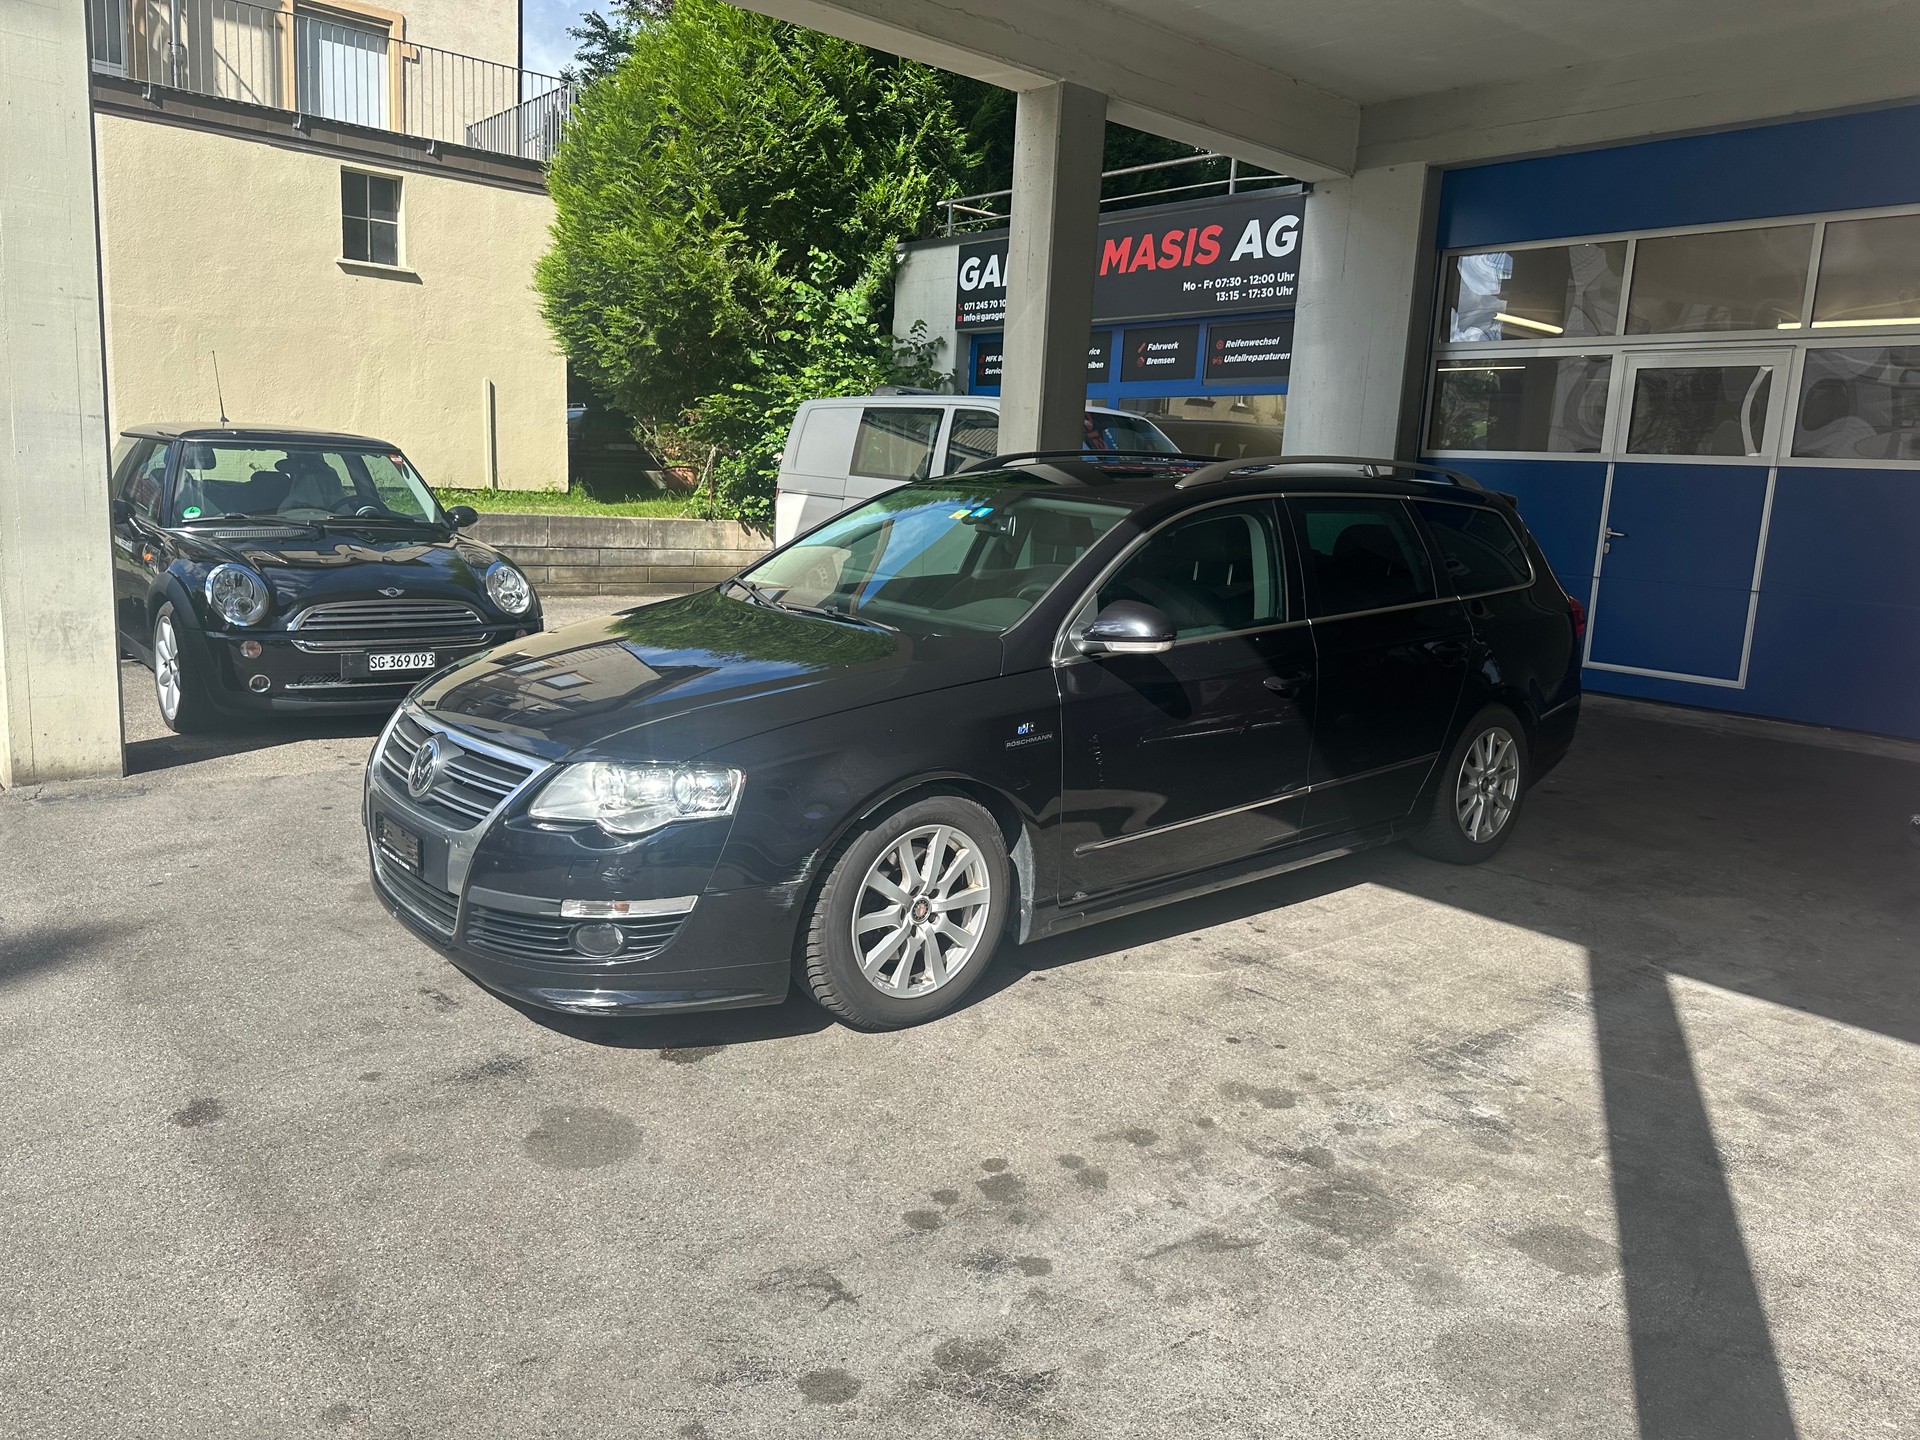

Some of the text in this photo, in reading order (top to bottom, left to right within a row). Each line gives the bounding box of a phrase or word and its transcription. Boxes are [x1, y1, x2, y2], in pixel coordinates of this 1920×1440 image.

[1099, 224, 1223, 276] MASIS
[1230, 214, 1300, 262] AG
[1183, 281, 1196, 291] Mo
[1203, 280, 1213, 289] Fr
[1215, 277, 1241, 288] 07:30
[1249, 273, 1275, 285] 12:00
[1277, 272, 1295, 282] Uhr
[1216, 290, 1239, 301] 13:15
[1248, 287, 1274, 298] 17:30
[1276, 286, 1294, 296] Uhr
[964, 301, 975, 310] 071
[976, 301, 988, 310] 245
[989, 300, 998, 308] 70
[1147, 341, 1179, 351] Fahrwerk
[1225, 336, 1280, 348] Reifenwechsel
[1146, 357, 1175, 365] Bremsen
[1224, 352, 1291, 363] Unfallreparaturen
